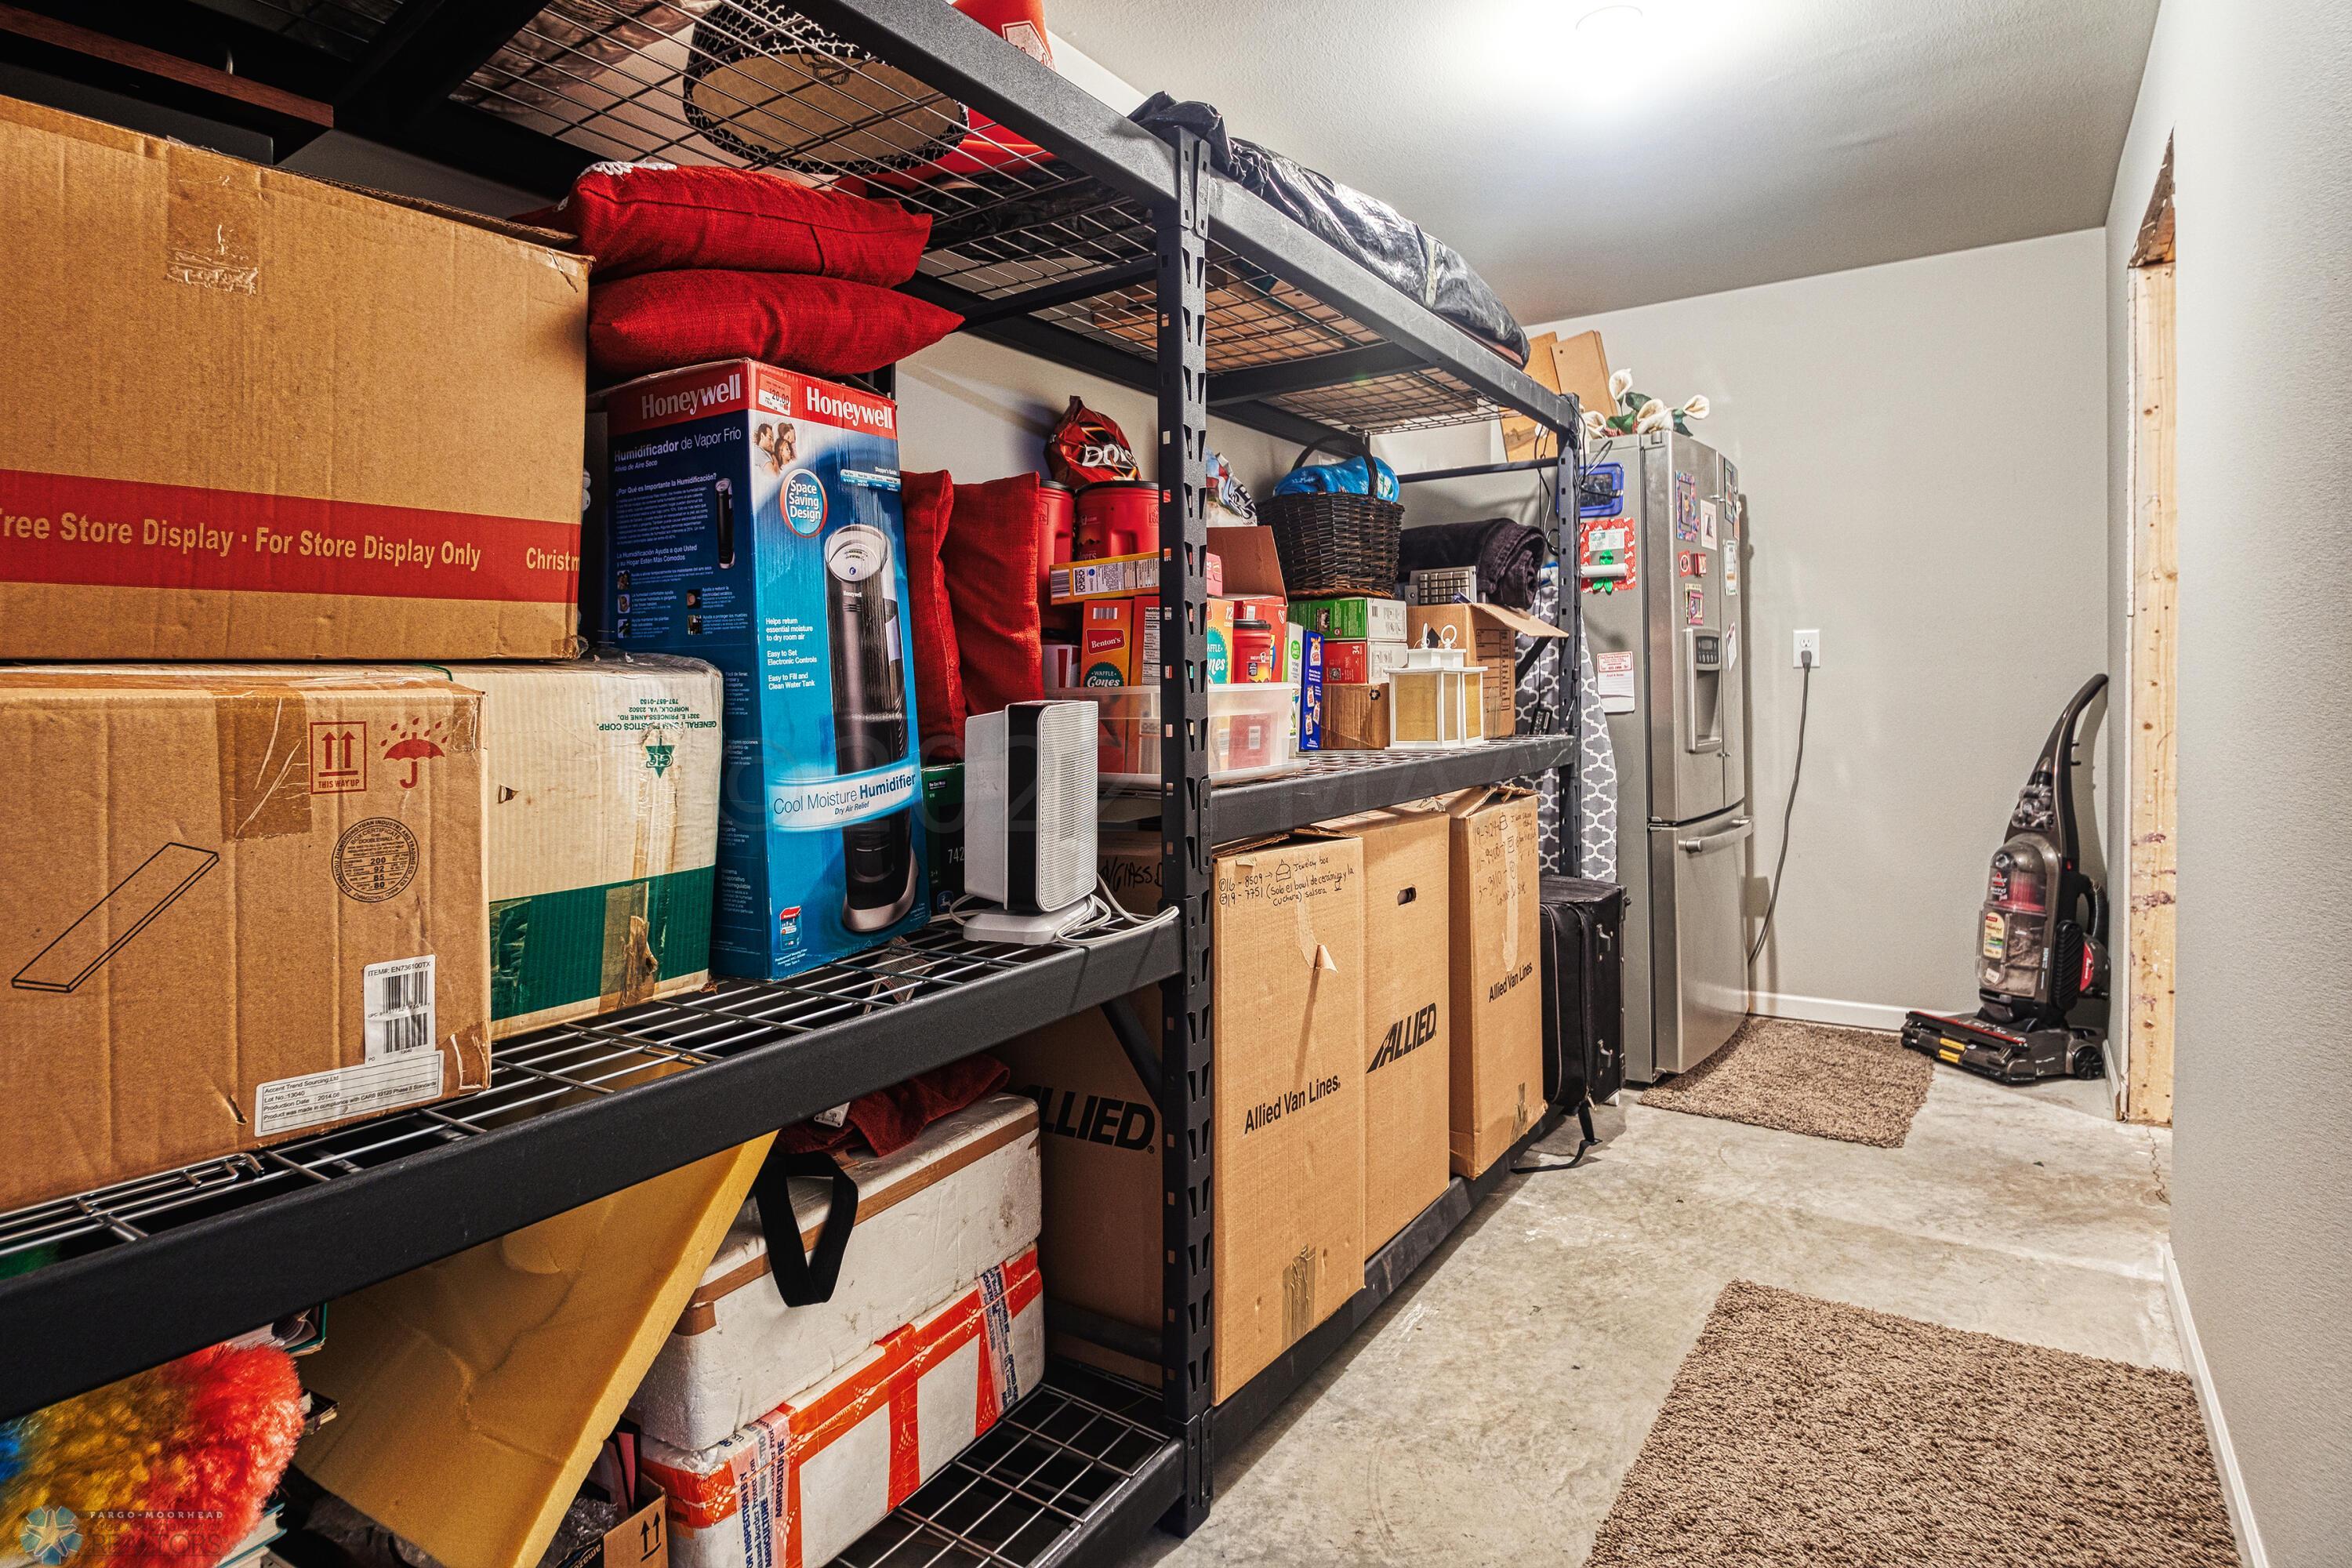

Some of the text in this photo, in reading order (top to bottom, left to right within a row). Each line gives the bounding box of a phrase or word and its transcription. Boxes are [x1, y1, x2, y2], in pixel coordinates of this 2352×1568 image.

[641, 373, 740, 419] Honeywell
[807, 386, 893, 430] Honeywell
[615, 426, 741, 462] Humidificador de Vapor Frío
[644, 481, 670, 491] Importante
[677, 473, 717, 485] Humidificación?
[790, 480, 817, 495] Space
[789, 492, 820, 510] Saving
[789, 506, 822, 522] Design
[0, 512, 49, 540] ree
[60, 512, 132, 544] Store
[143, 518, 233, 557] Display
[256, 528, 292, 554] For
[299, 530, 357, 559] Store
[364, 535, 435, 569] Display
[441, 541, 481, 572] Only
[1225, 606, 1233, 619] 12
[1091, 637, 1122, 648] Benton's
[1087, 676, 1120, 688] Cones
[597, 722, 622, 731] CORP.
[318, 779, 360, 789] THIS WAY UP
[774, 773, 916, 815] Cool Moisture Humidifier
[835, 801, 869, 815] Dry Air Relief
[375, 820, 403, 832] INDUSTRY
[1319, 856, 1329, 865] box
[368, 968, 390, 978] ITEM#:
[1489, 977, 1507, 1003] Allied
[1508, 972, 1519, 989] Van
[1367, 1002, 1436, 1074] ALLIED
[264, 1085, 285, 1094] Accent
[263, 1112, 285, 1121] Product
[320, 1099, 348, 1109] compliance
[413, 1081, 436, 1090] Standards
[263, 1102, 295, 1112] Production
[1244, 1096, 1281, 1134] Allied
[1283, 1091, 1305, 1115] Van
[740, 1493, 753, 1553] INSPECTION
[760, 1497, 772, 1568] AGRICULTURE
